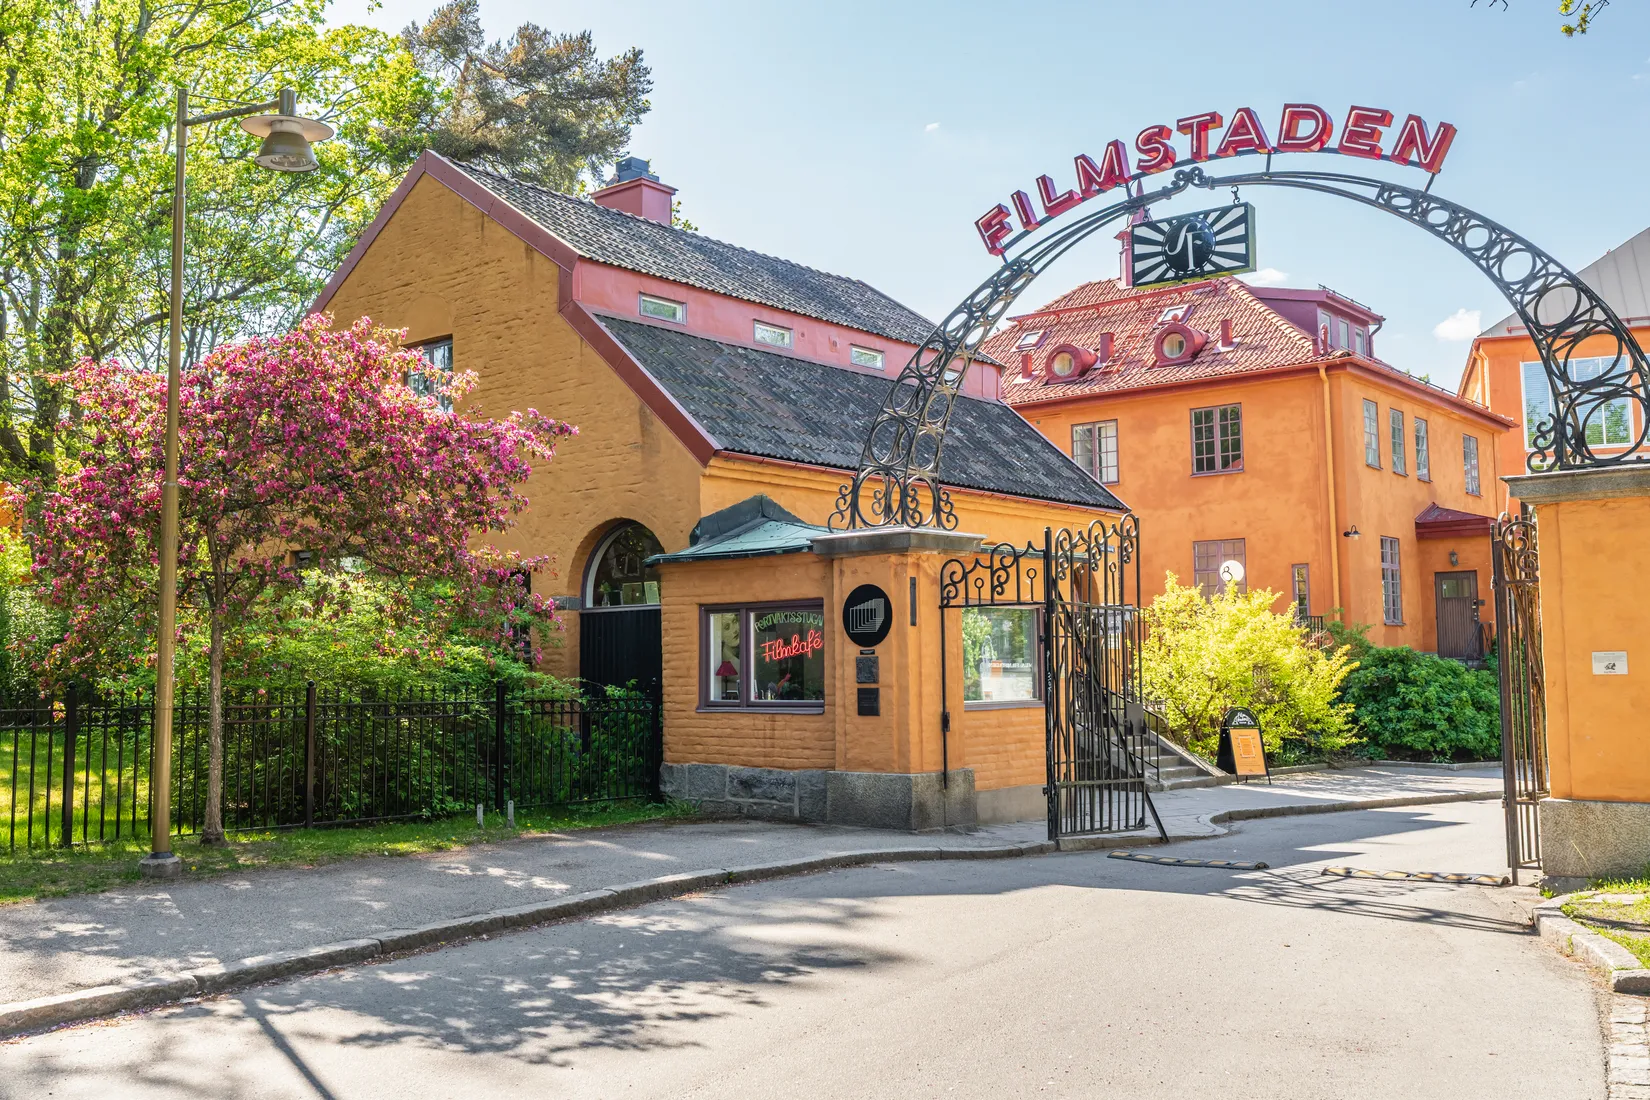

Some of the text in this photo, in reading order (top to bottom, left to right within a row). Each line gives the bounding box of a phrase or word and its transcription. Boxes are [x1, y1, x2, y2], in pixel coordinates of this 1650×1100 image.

[974, 103, 1458, 257] FILMSTADEN
[1165, 221, 1206, 271] SF
[760, 629, 824, 663] Filmkafé
